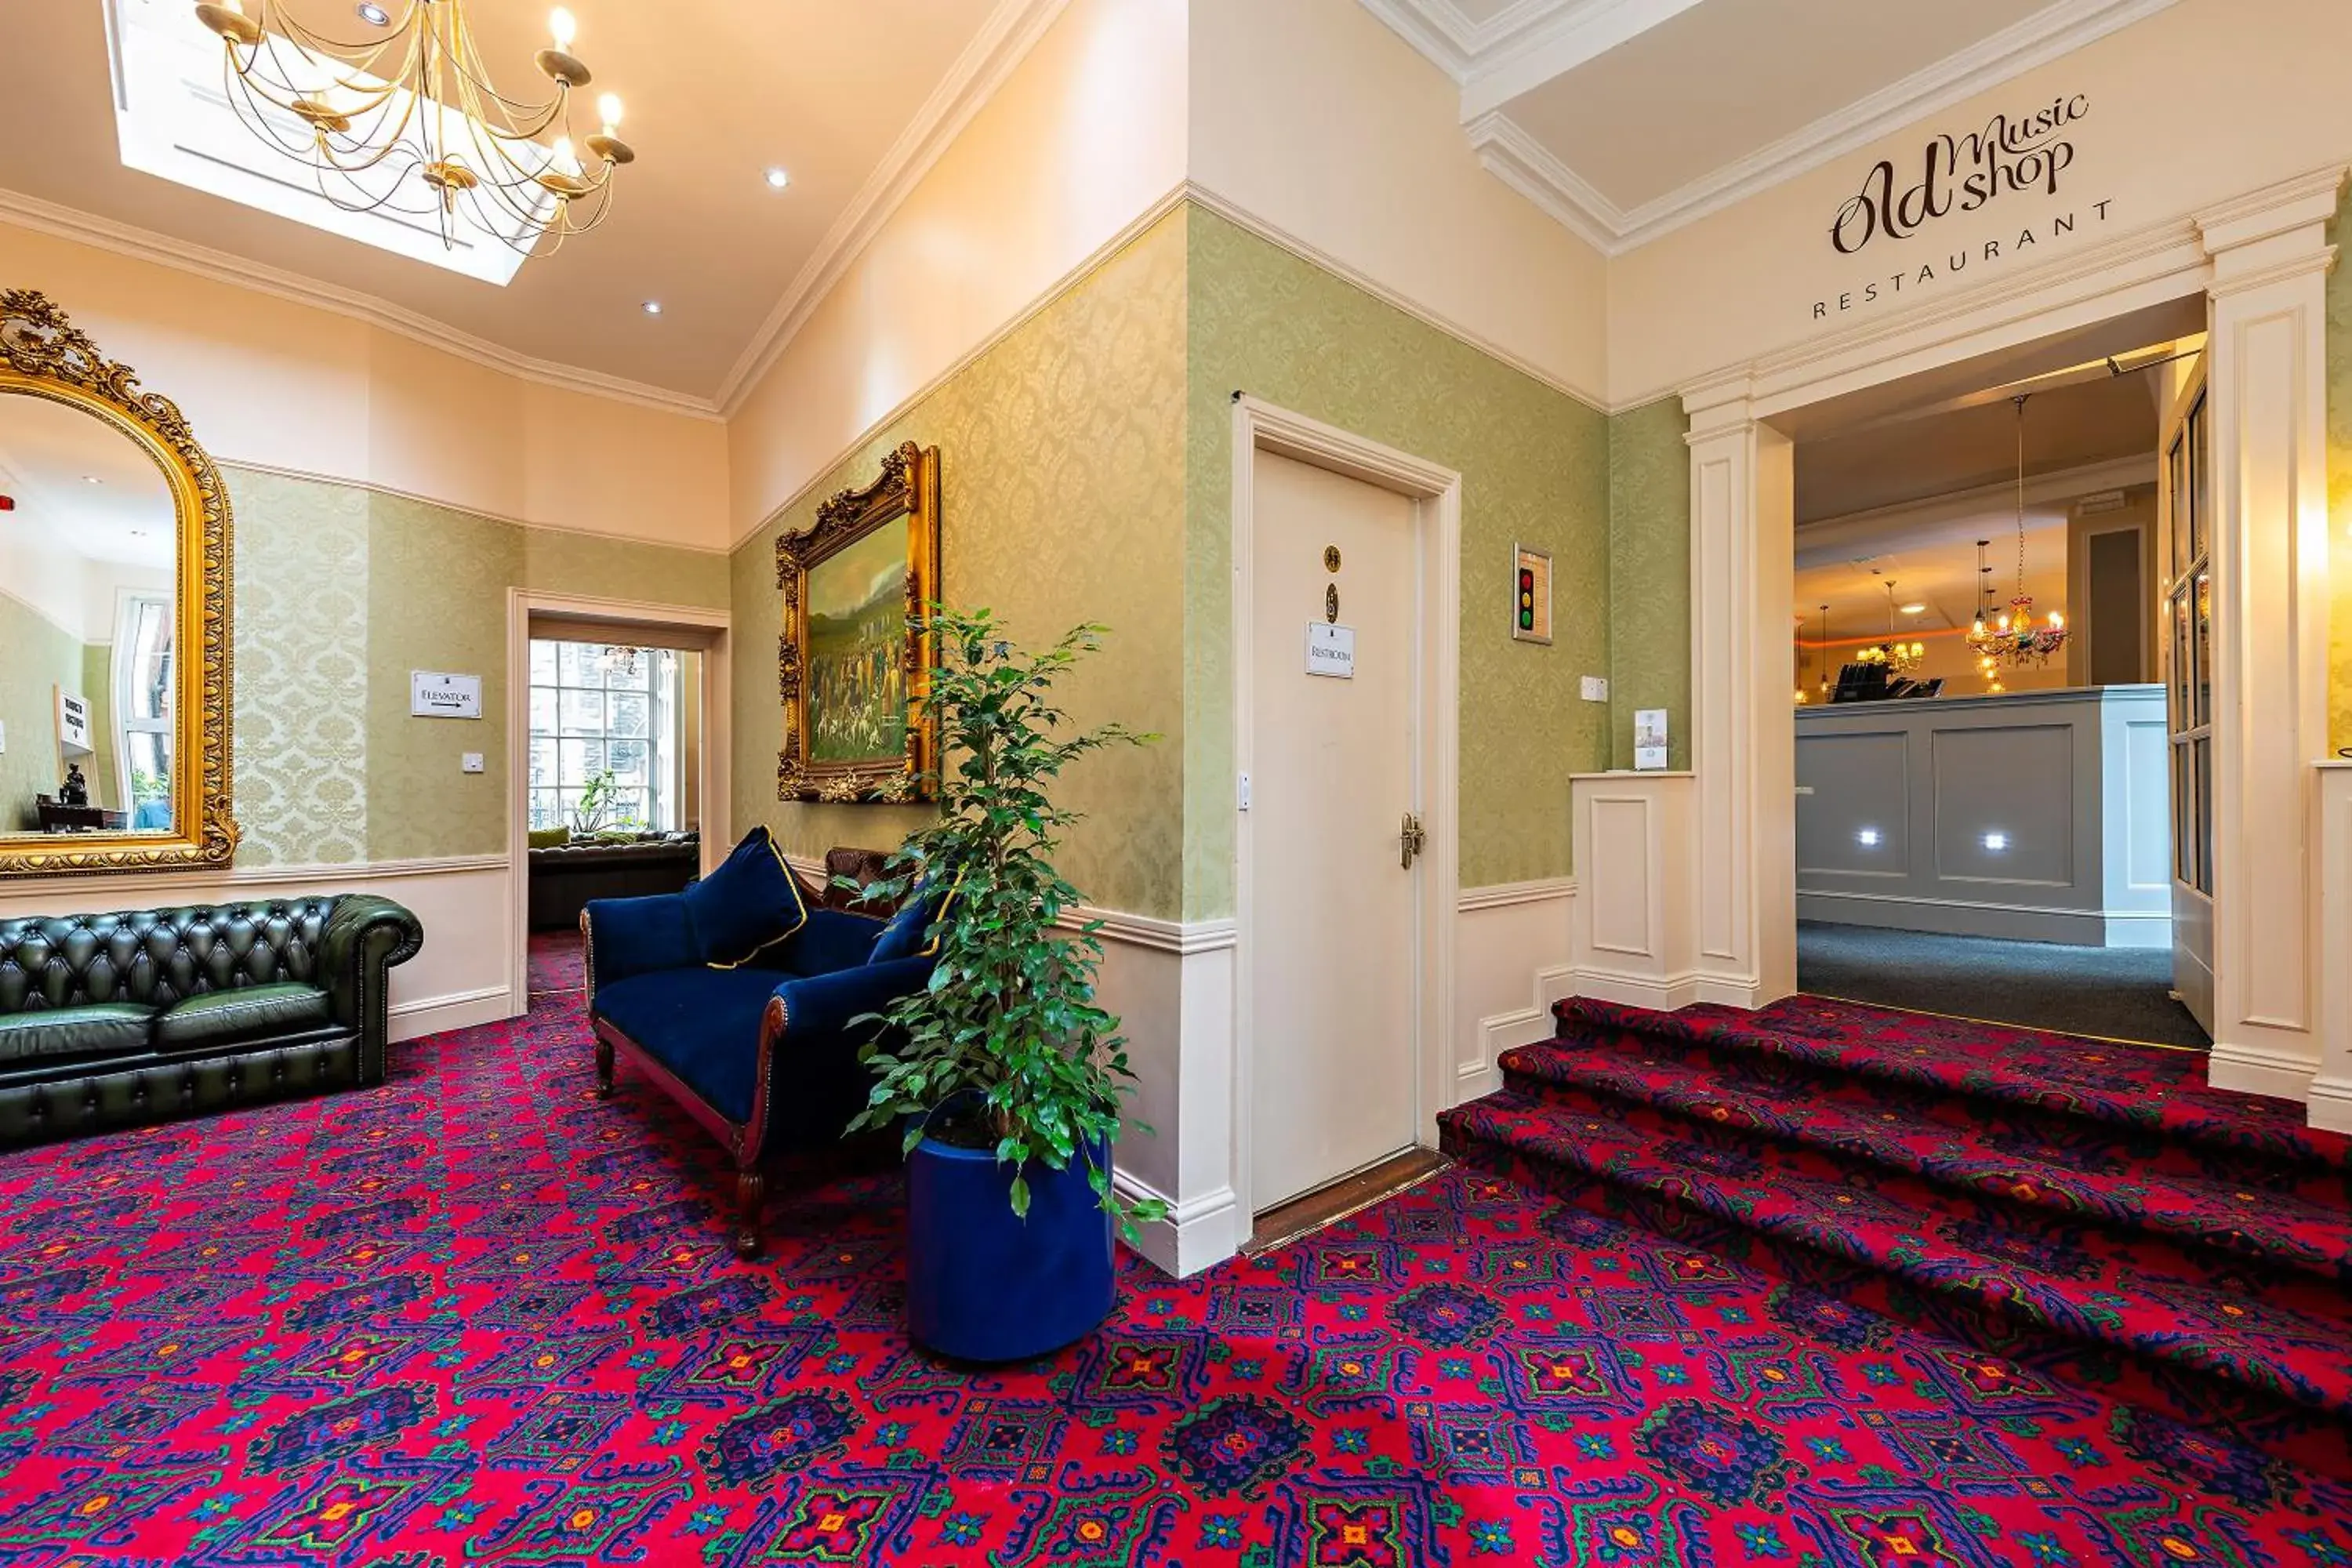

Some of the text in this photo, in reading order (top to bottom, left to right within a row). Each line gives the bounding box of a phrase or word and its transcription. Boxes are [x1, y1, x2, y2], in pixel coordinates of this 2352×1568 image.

[1828, 93, 2089, 254] Old Music
[1813, 198, 2113, 320] RESTAURANT
